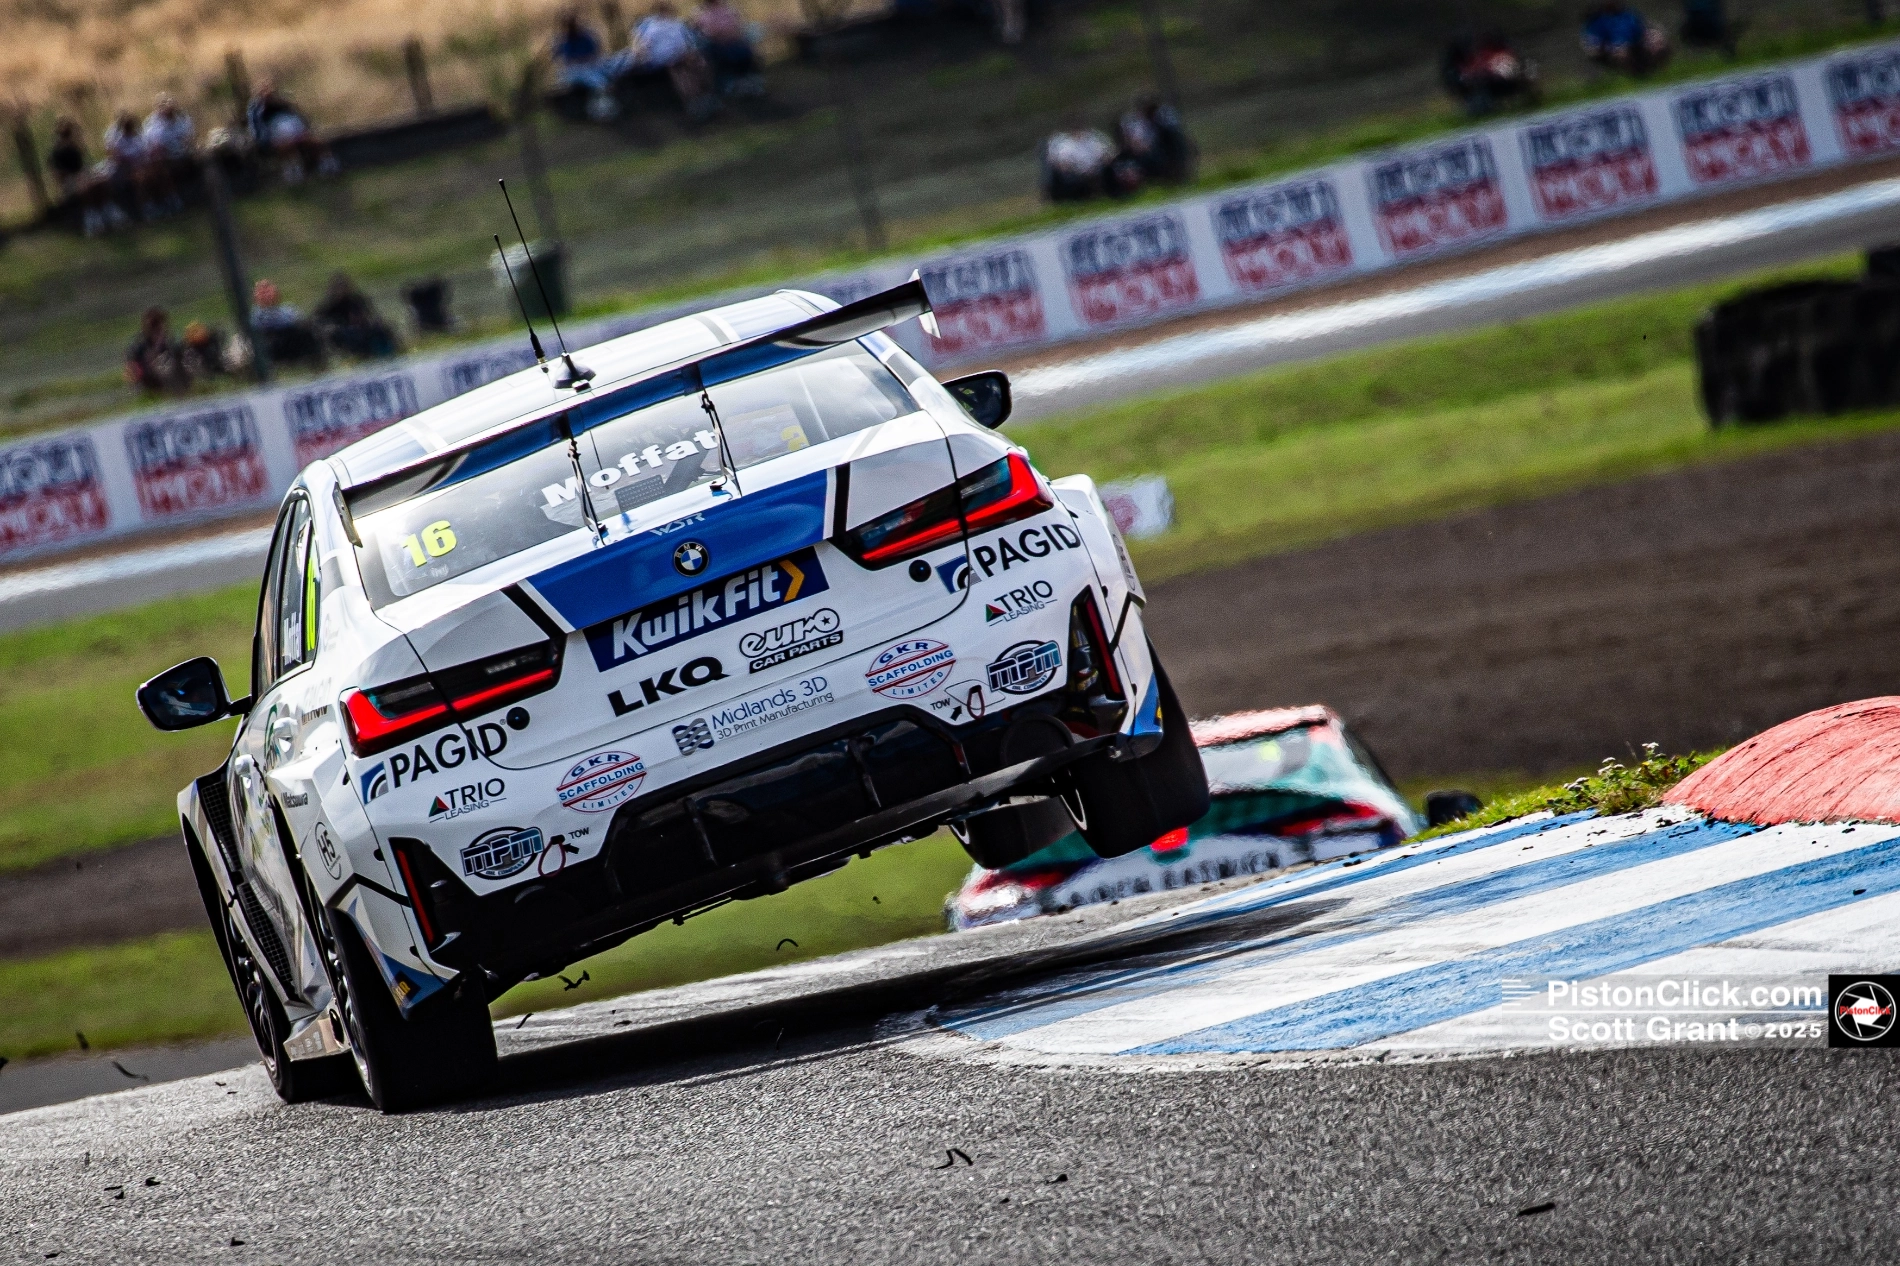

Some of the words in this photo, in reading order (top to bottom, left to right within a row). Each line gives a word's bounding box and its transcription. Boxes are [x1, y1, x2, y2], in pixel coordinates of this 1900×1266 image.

[542, 430, 718, 508] Moffat
[402, 520, 458, 568] 16
[674, 543, 703, 558] BMW
[973, 524, 1081, 577] PAGID
[995, 580, 1053, 608] TRIO
[1004, 600, 1045, 623] LEASING
[739, 608, 840, 658] euro
[752, 653, 786, 670] CAR
[788, 633, 841, 659] PARTS
[868, 649, 954, 687] SCAFFOLDING
[879, 642, 929, 664] GKR
[607, 656, 731, 717] LKQ
[892, 671, 944, 695] LIMITED
[712, 688, 797, 729] Midlands
[799, 676, 828, 697] 3D
[716, 727, 732, 740] 3D
[733, 718, 758, 733] Print
[759, 692, 835, 725] Manufacturing
[930, 698, 951, 710] TOW
[389, 722, 507, 788] PAGID
[571, 754, 620, 777] GKR
[445, 778, 505, 810] TRIO
[559, 762, 644, 801] SCAFFOLDING
[582, 783, 634, 808] LIMITED
[444, 799, 490, 820] LEASING
[568, 827, 590, 840] TOW
